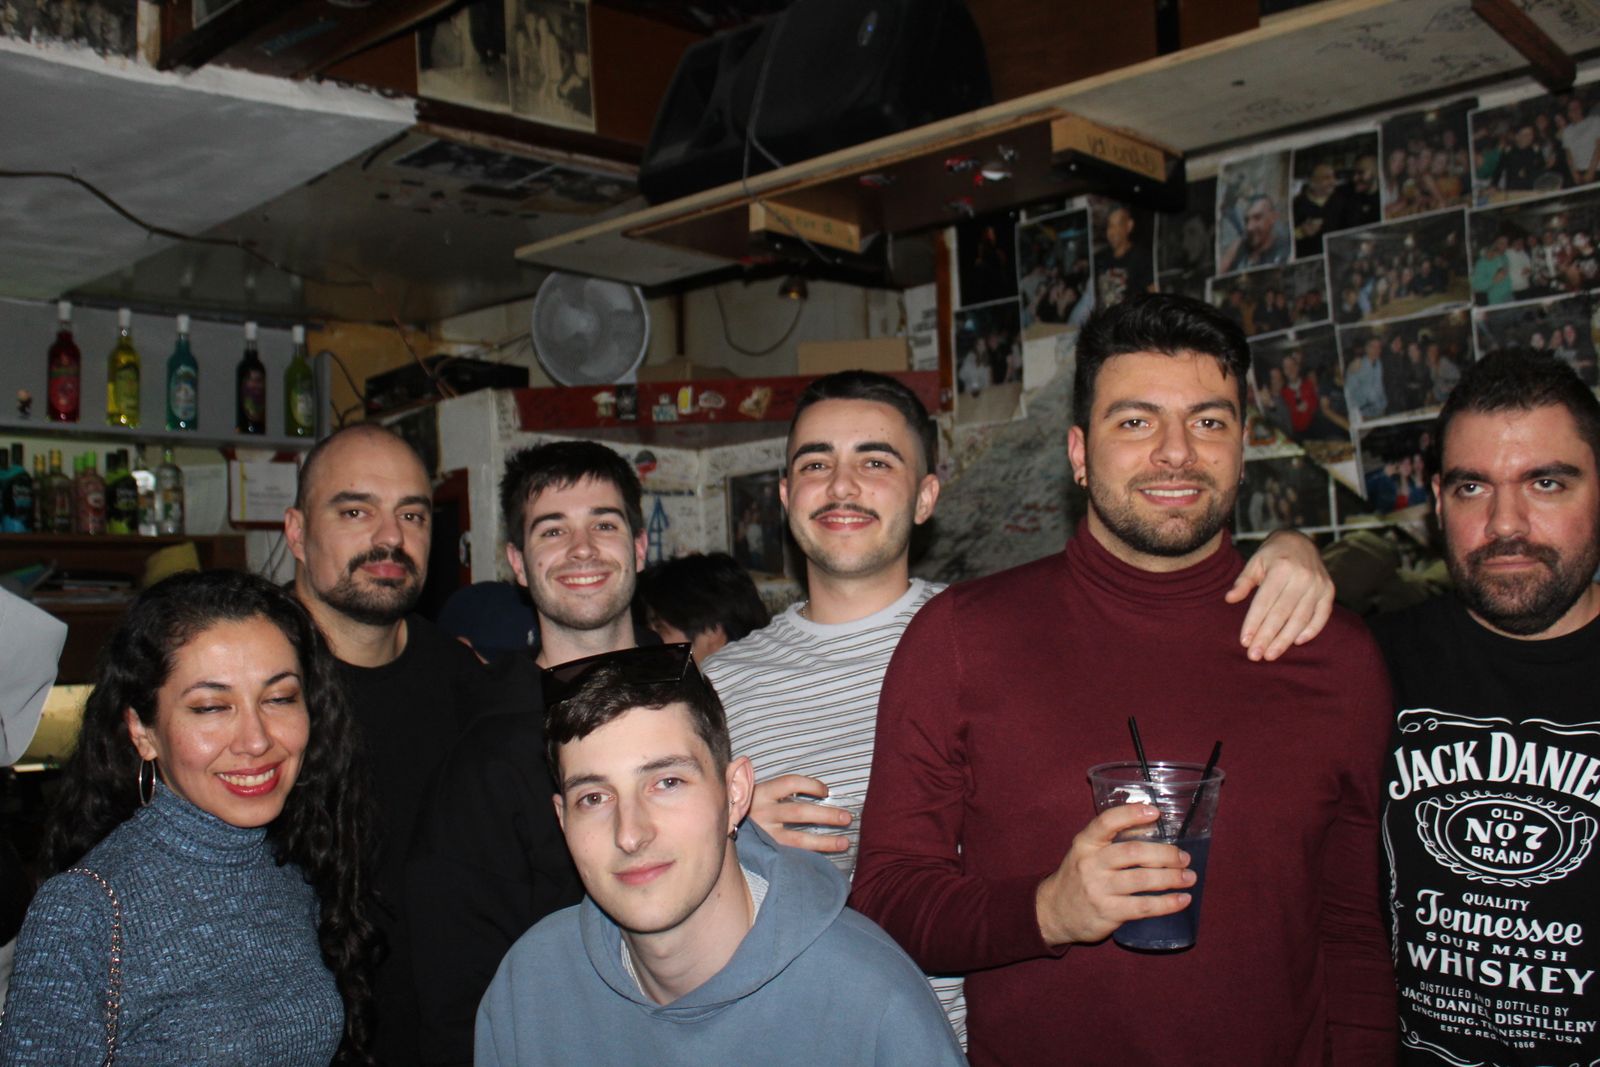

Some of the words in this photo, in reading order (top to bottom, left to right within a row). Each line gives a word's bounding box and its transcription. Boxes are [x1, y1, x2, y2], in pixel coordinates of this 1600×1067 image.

[1388, 740, 1483, 800] JACK
[1486, 732, 1600, 807] DANIE
[1491, 808, 1524, 821] OLD
[1471, 845, 1534, 865] BRAND
[1415, 889, 1584, 946] Tennessee
[1462, 892, 1530, 912] QUALITY
[1426, 931, 1480, 952] SOUR
[1491, 943, 1567, 962] MASH
[1406, 941, 1595, 995] WHISKEY
[1402, 987, 1432, 1006] JACK
[1435, 998, 1491, 1020] DANIEL
[1495, 1013, 1597, 1033] DISTILLERY
[1420, 981, 1471, 999] DISTILLED
[1496, 1000, 1549, 1015] BOTTLED
[1554, 1006, 1569, 1017] BY
[1440, 1024, 1461, 1034] EST.
[1464, 1028, 1472, 1036] &
[1555, 1034, 1582, 1045] USA
